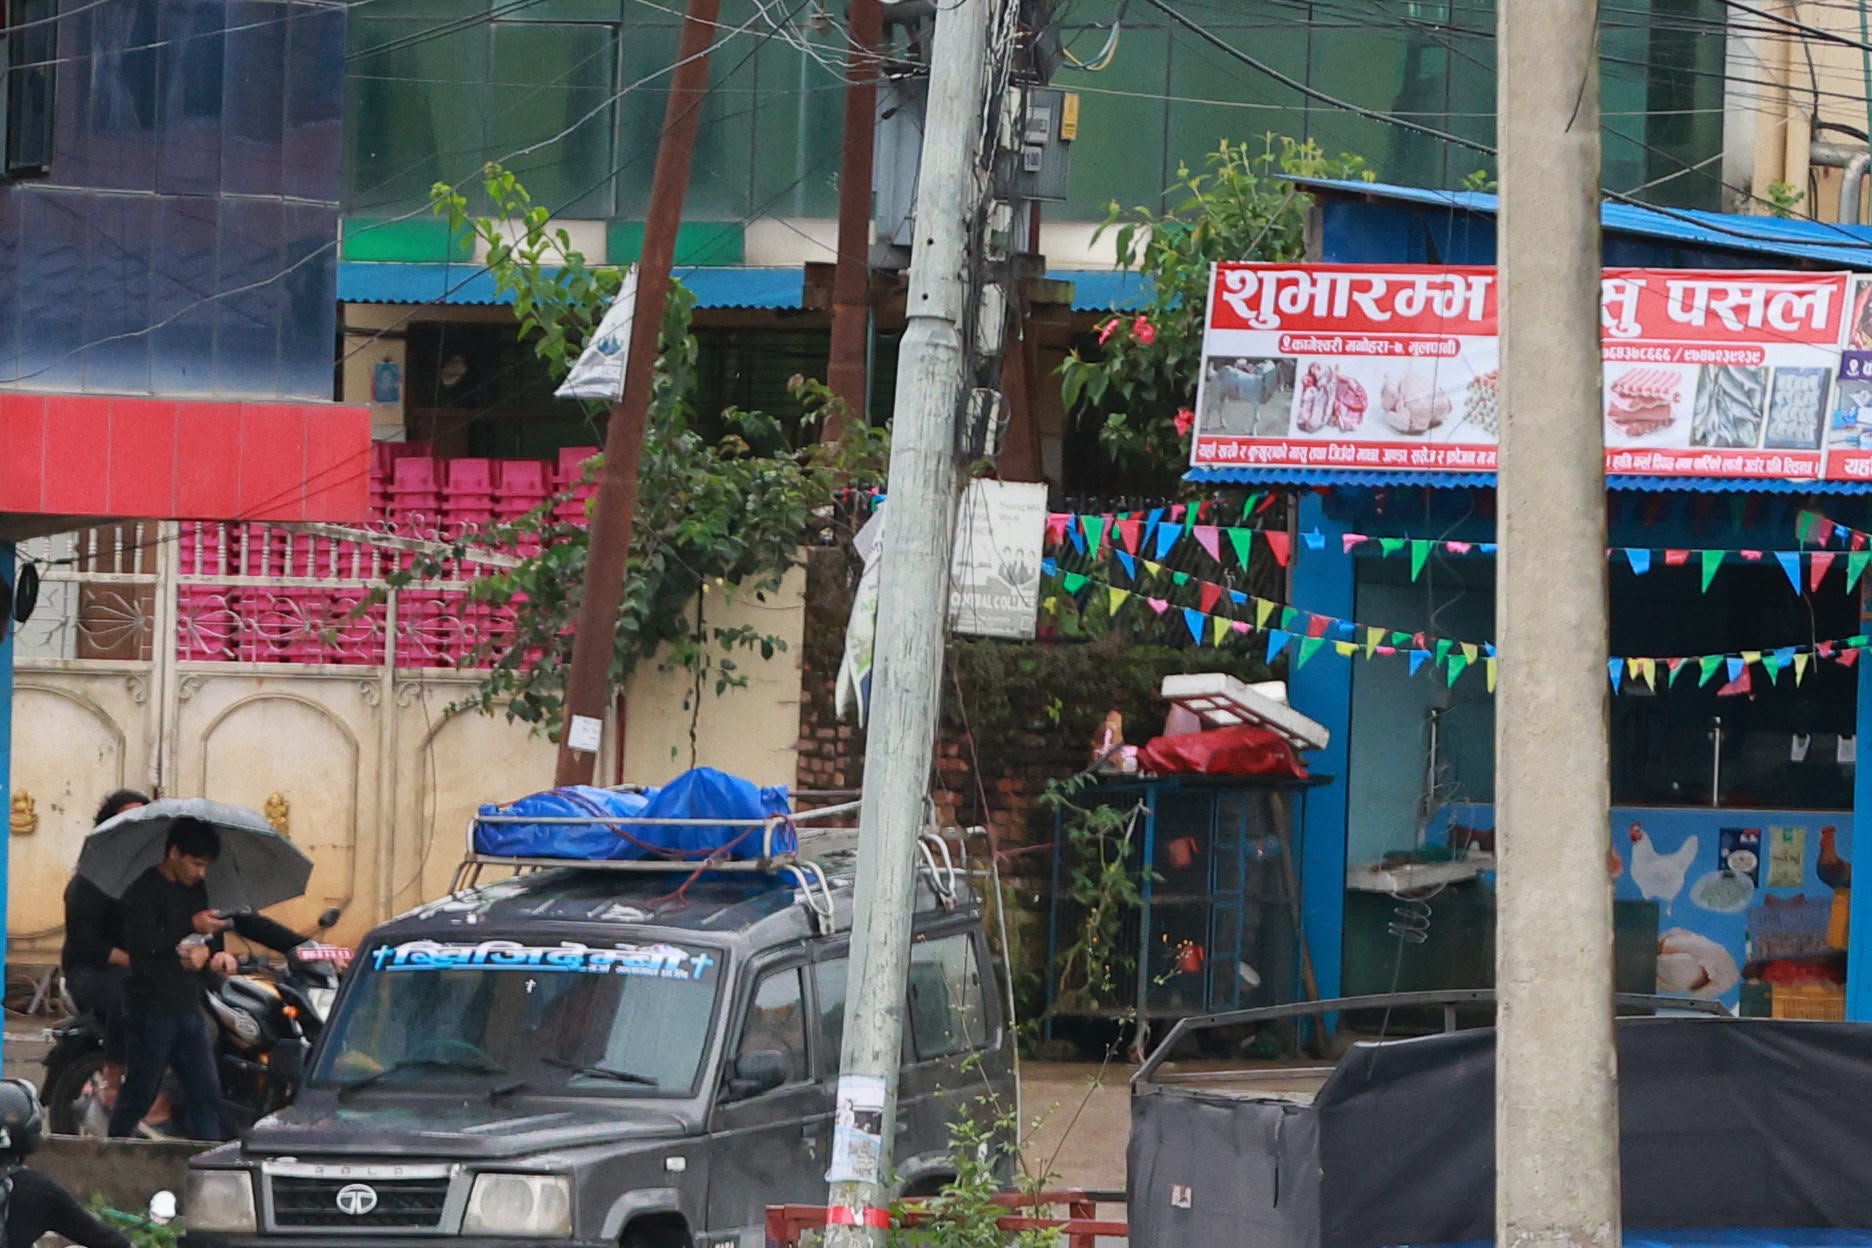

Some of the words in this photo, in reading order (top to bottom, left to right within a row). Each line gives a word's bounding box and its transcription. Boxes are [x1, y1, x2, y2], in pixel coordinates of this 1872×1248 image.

[1223, 269, 1493, 330] शुभारम्भ
[1602, 278, 1647, 338] सु
[1666, 279, 1839, 332] पसल
[1844, 458, 1872, 477] यह
